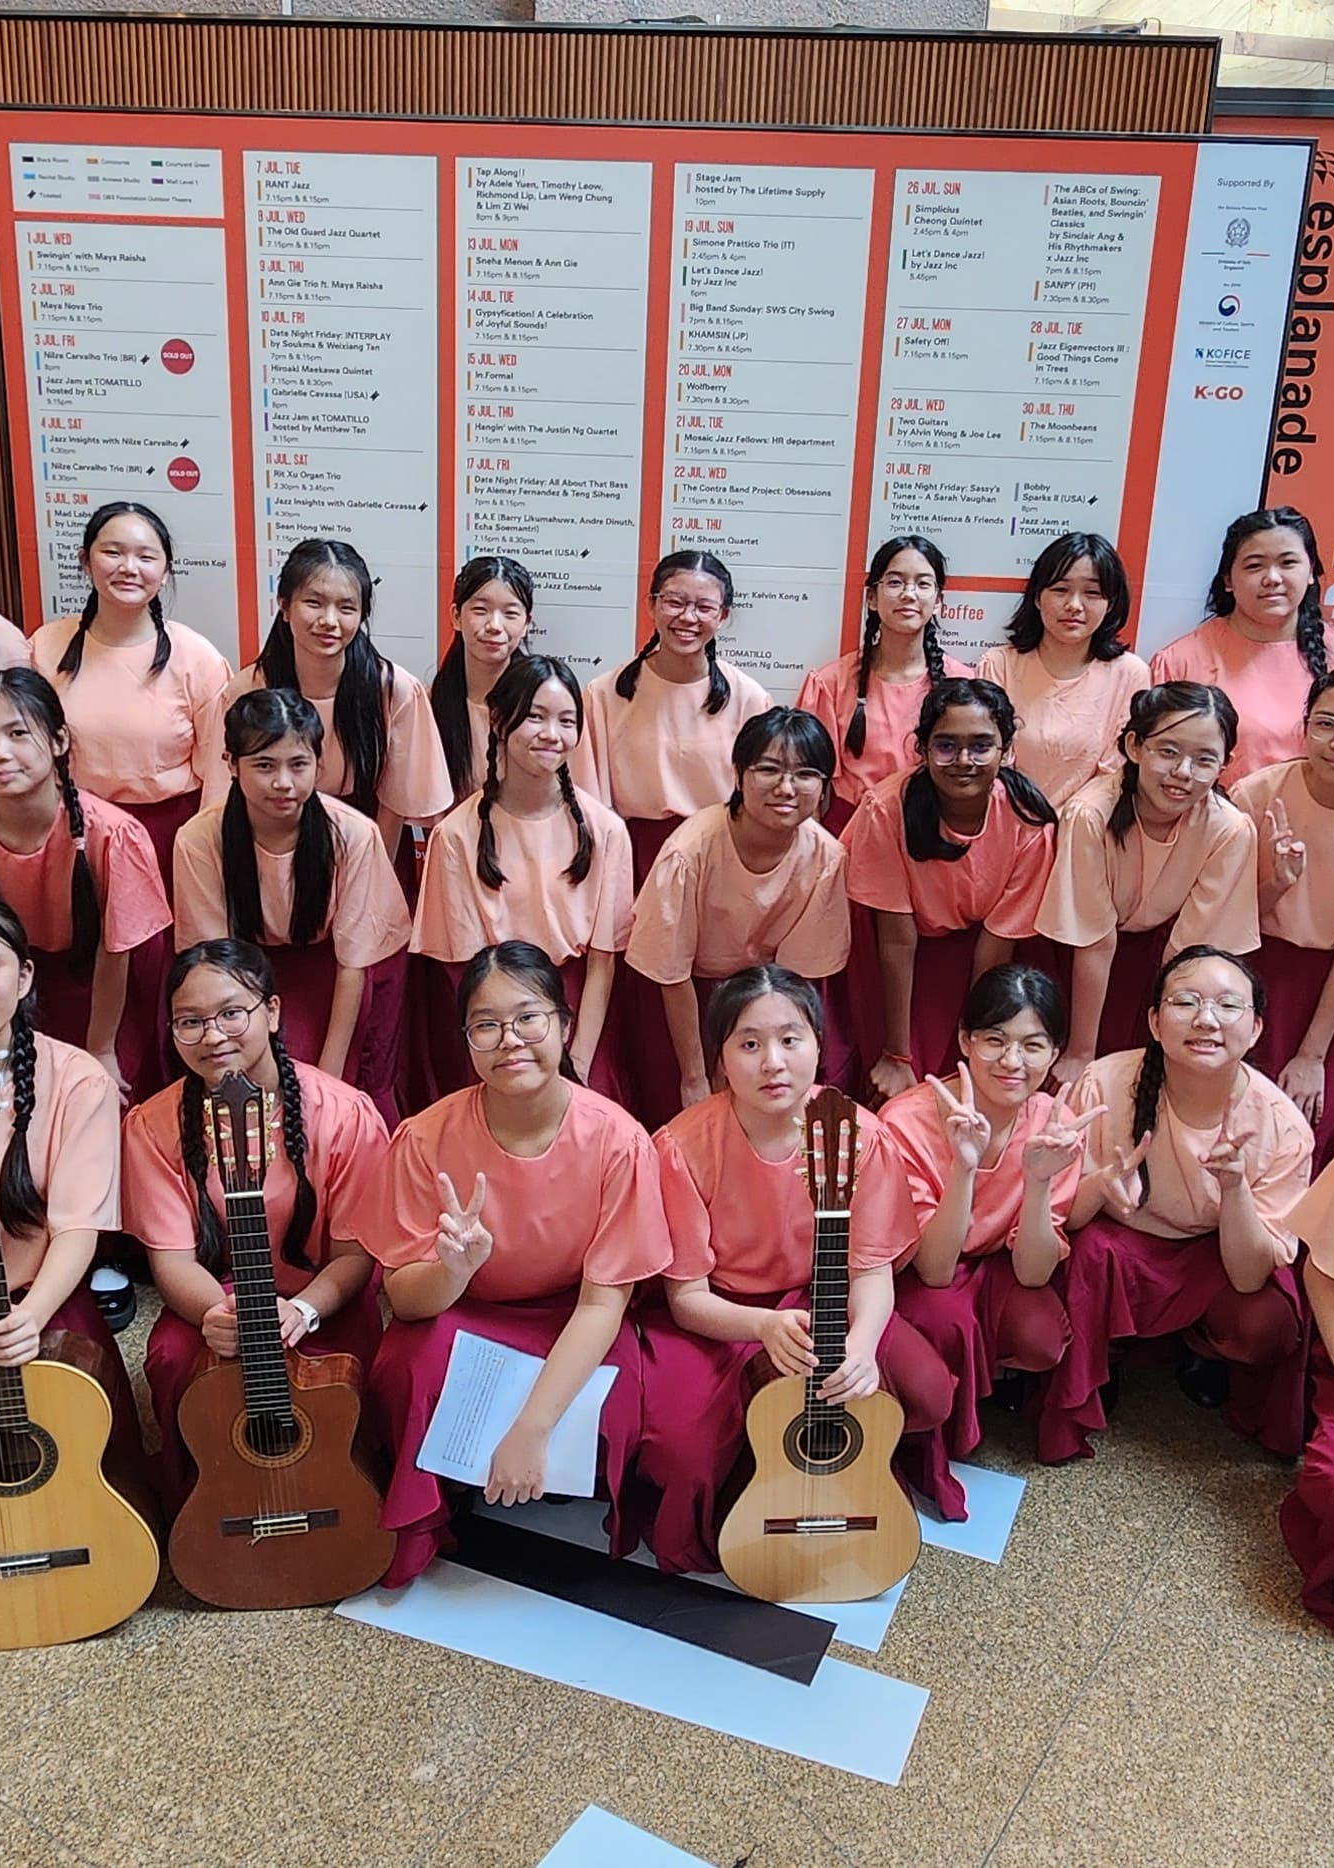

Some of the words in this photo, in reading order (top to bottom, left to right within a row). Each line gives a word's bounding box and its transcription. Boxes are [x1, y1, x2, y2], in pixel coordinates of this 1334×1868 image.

[257, 160, 261, 173] 7
[285, 161, 300, 174] TUE
[695, 173, 720, 182] Stage
[722, 174, 741, 182] Jam
[265, 180, 289, 188] RANT
[291, 181, 309, 189] Jazz
[907, 181, 919, 193] 26
[943, 182, 961, 195] SUN
[1217, 178, 1261, 188] Supported
[1263, 180, 1275, 189] By
[694, 185, 725, 193] hosted
[726, 185, 737, 194] by
[739, 186, 755, 194] The
[757, 186, 793, 195] Lifetime
[795, 187, 825, 198] Supply
[1054, 184, 1070, 192] The
[1072, 185, 1096, 193] ABCs
[1098, 185, 1108, 194] of
[1109, 186, 1140, 196] Swing:
[476, 201, 483, 209] &
[485, 201, 501, 209] Lim
[502, 202, 511, 210] Zi
[513, 202, 529, 210] Wei
[915, 204, 959, 214] Simplicius
[684, 219, 693, 231] 19
[717, 220, 734, 233] SUN
[914, 216, 947, 226] Cheong
[949, 217, 982, 225] Quintet
[266, 226, 282, 234] The
[283, 227, 298, 235] Old
[300, 227, 326, 235] Guard
[348, 229, 380, 237] Quartet
[27, 232, 31, 243] 1
[53, 232, 72, 245] WED
[692, 238, 725, 246] Simone
[727, 239, 760, 247] Prattico
[762, 240, 778, 248] Trio
[780, 241, 795, 250] (IT)
[1043, 280, 1076, 289] SANPY
[1077, 282, 1096, 290] (PH)
[40, 301, 62, 310] Maya
[290, 330, 313, 339] Night
[315, 330, 342, 339] Friday:
[345, 331, 391, 340] INTERPLAY
[688, 330, 730, 338] KHAMSIN
[732, 331, 748, 340] (JP)
[1206, 348, 1251, 360] KOFICE
[94, 378, 142, 386] TOMATILLO
[686, 382, 727, 391] Wolfberry
[917, 417, 948, 425] Guitars
[1030, 421, 1045, 429] The
[1047, 422, 1097, 431] Moonbeans
[682, 483, 697, 491] The
[698, 484, 727, 492] Contra
[751, 486, 782, 495] Project:
[784, 488, 831, 496] Obsessions
[940, 604, 984, 620] Coffee
